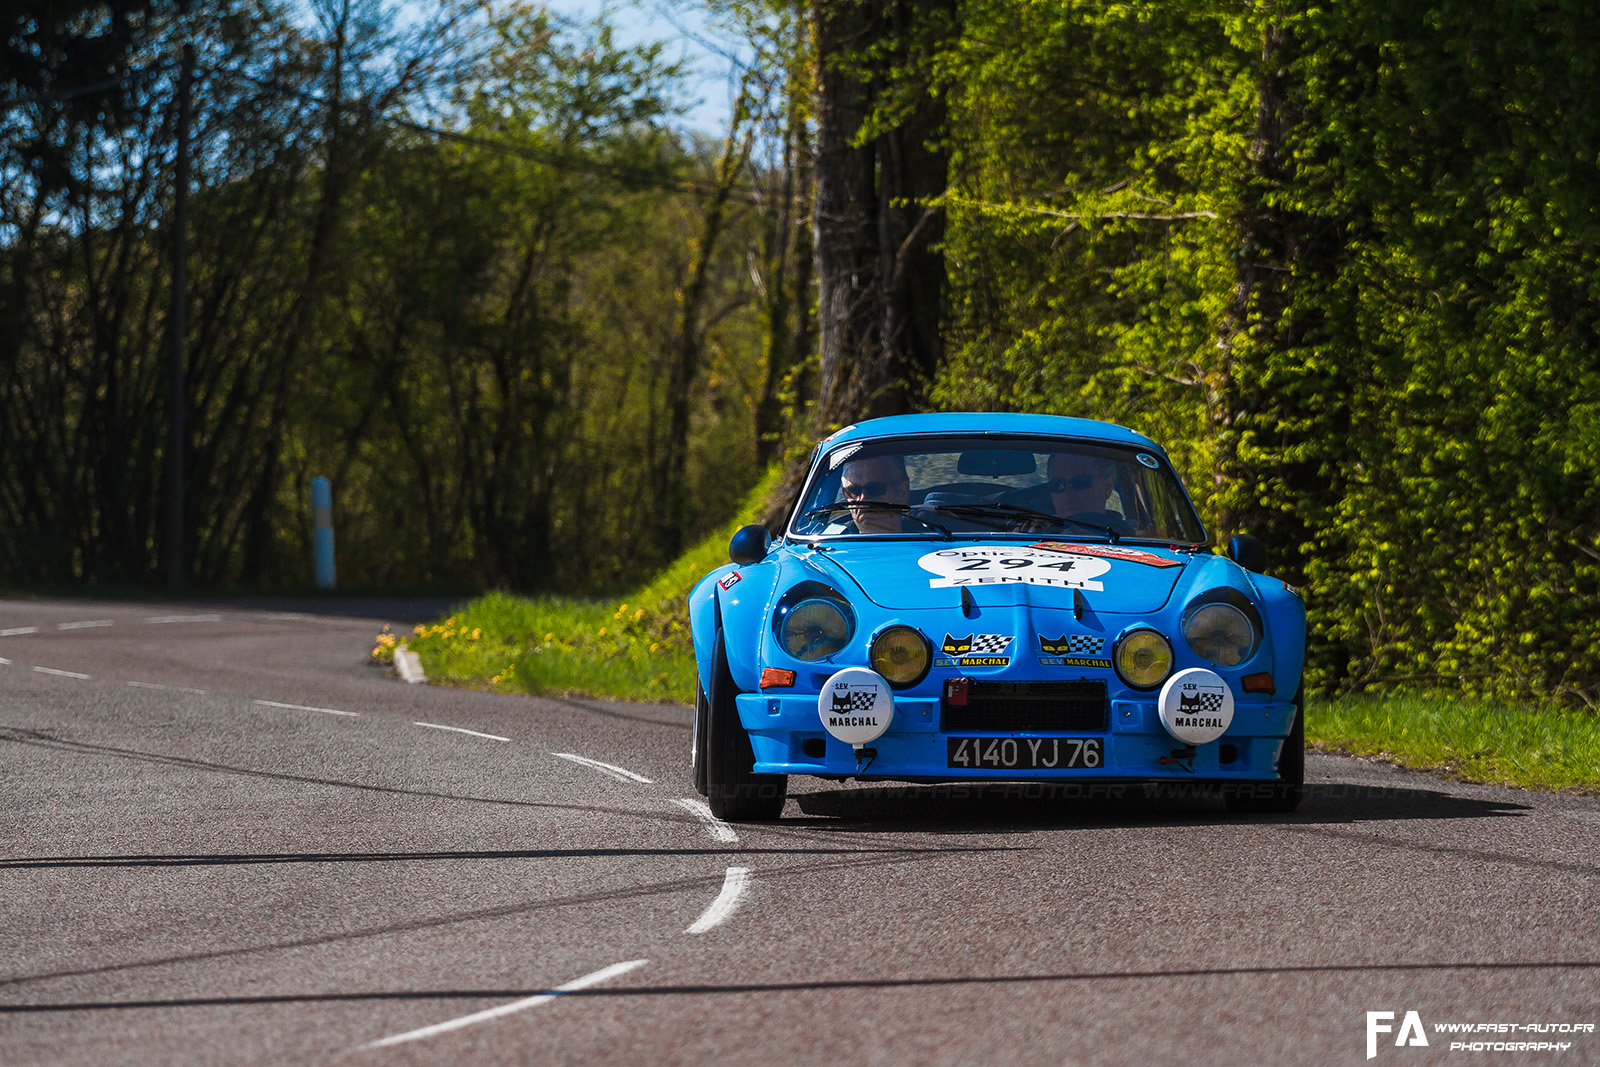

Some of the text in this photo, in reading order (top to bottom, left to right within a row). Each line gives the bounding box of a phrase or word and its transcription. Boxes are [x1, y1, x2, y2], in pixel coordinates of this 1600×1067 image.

[935, 550, 1014, 558] Optic
[955, 558, 1076, 572] 294
[953, 576, 1085, 588] ZENITH
[961, 657, 1008, 667] MARCHAL
[1066, 659, 1111, 669] MARCHAL
[829, 716, 878, 727] MARCHAL
[1175, 717, 1223, 728] MARCHAL
[953, 738, 1100, 768] 4140 YJ 76
